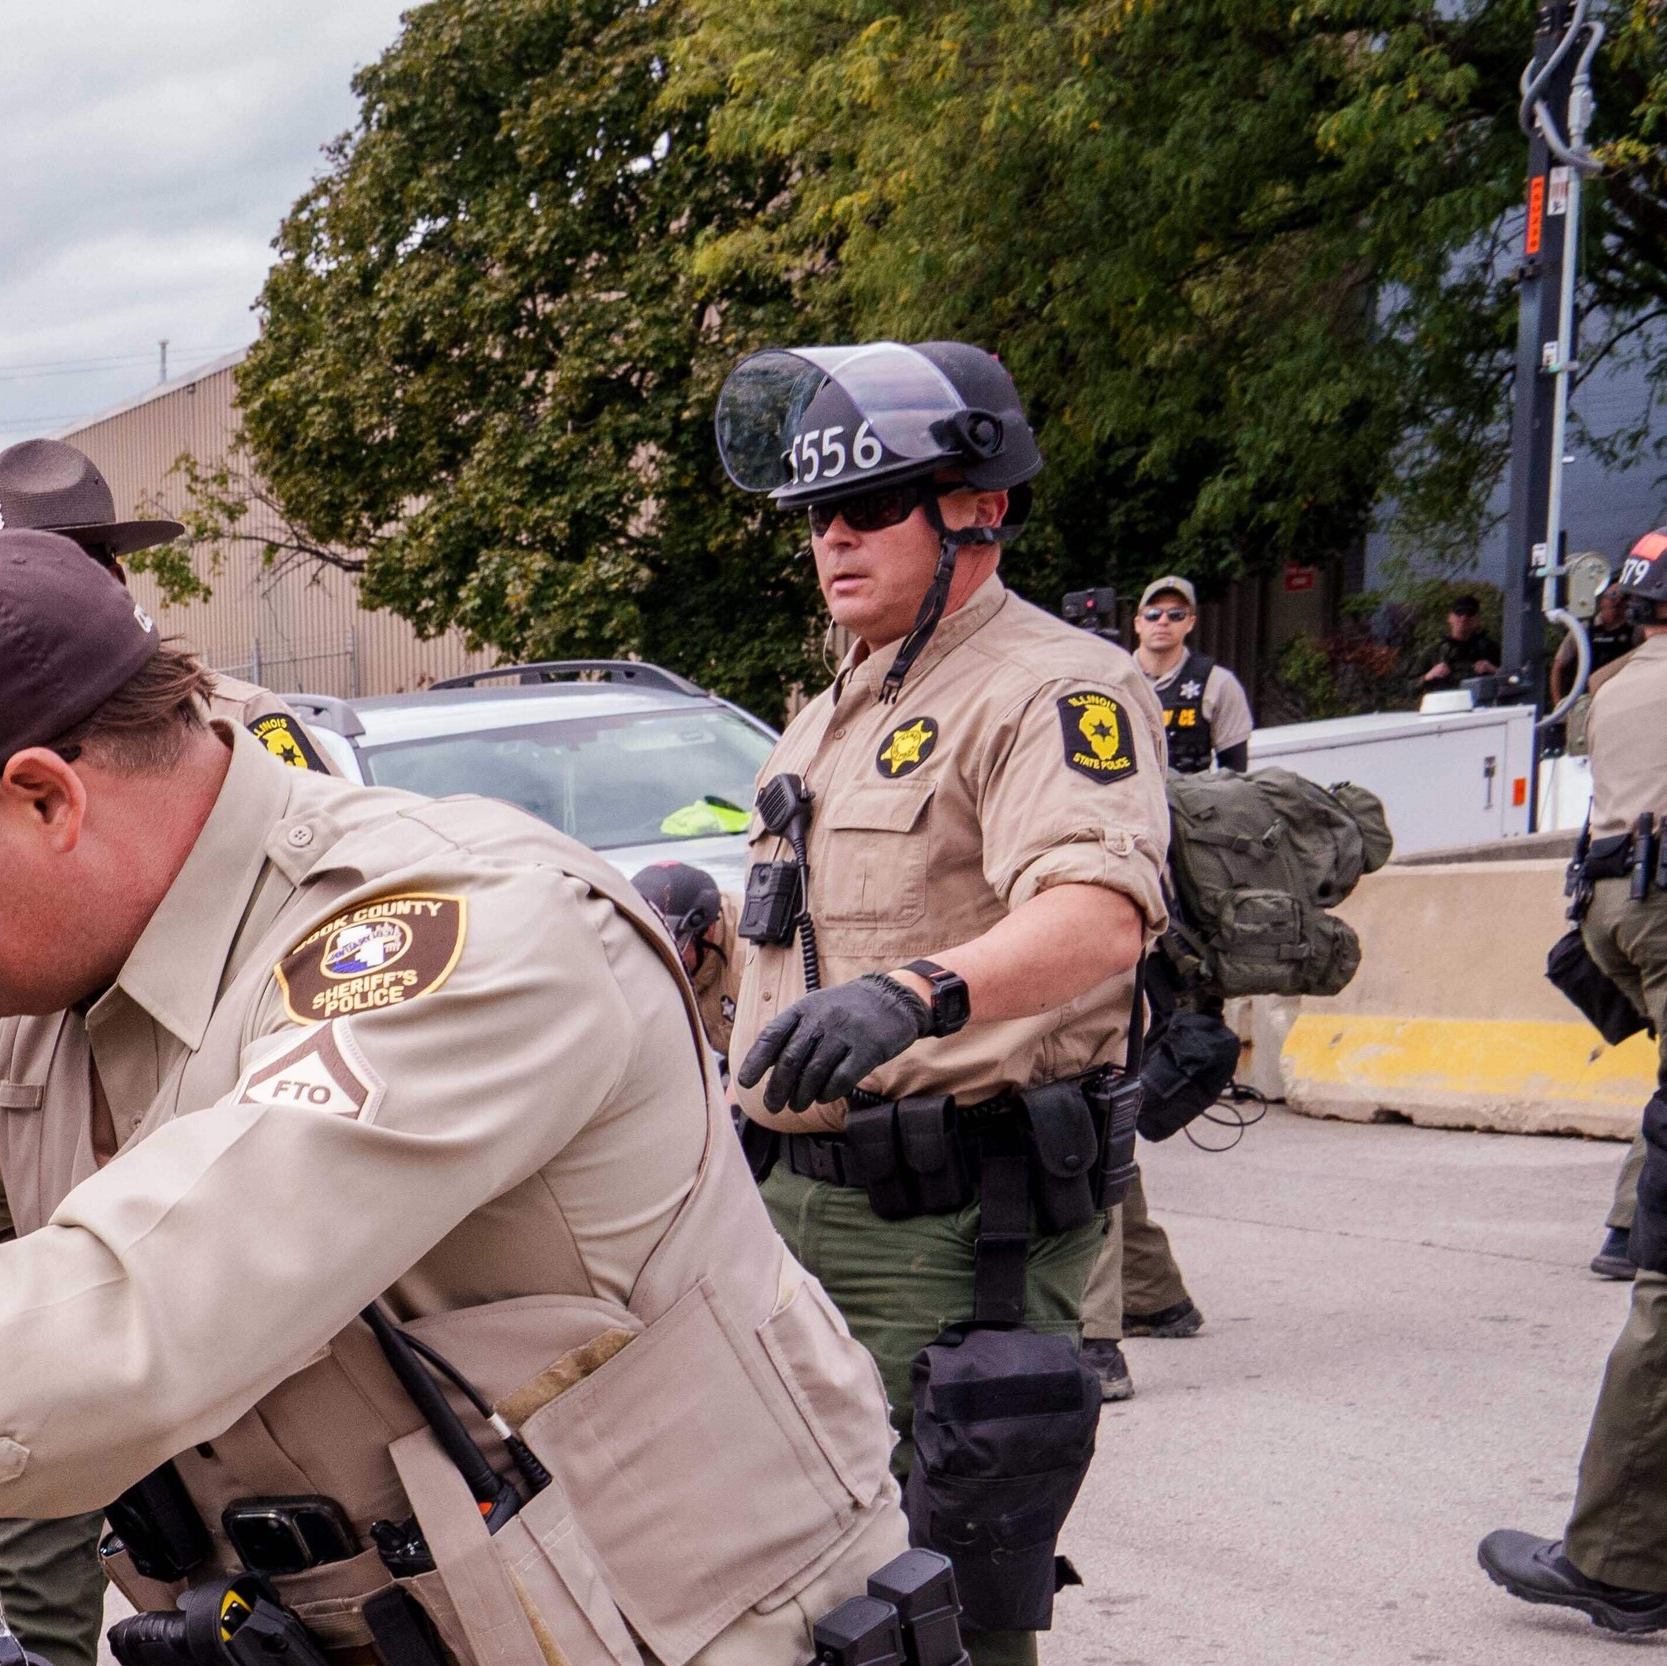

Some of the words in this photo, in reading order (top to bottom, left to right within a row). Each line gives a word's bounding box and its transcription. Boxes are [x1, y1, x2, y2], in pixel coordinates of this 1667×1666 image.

[1068, 694, 1117, 712] ILLINOIS
[253, 718, 287, 737] LINOIS
[1073, 752, 1100, 769] STATE
[1100, 756, 1131, 770] POLICE
[353, 900, 443, 922] COUNTY
[311, 969, 418, 1010] SHERIFF'S
[324, 985, 405, 1017] POLICE
[272, 1080, 332, 1105] FTO
